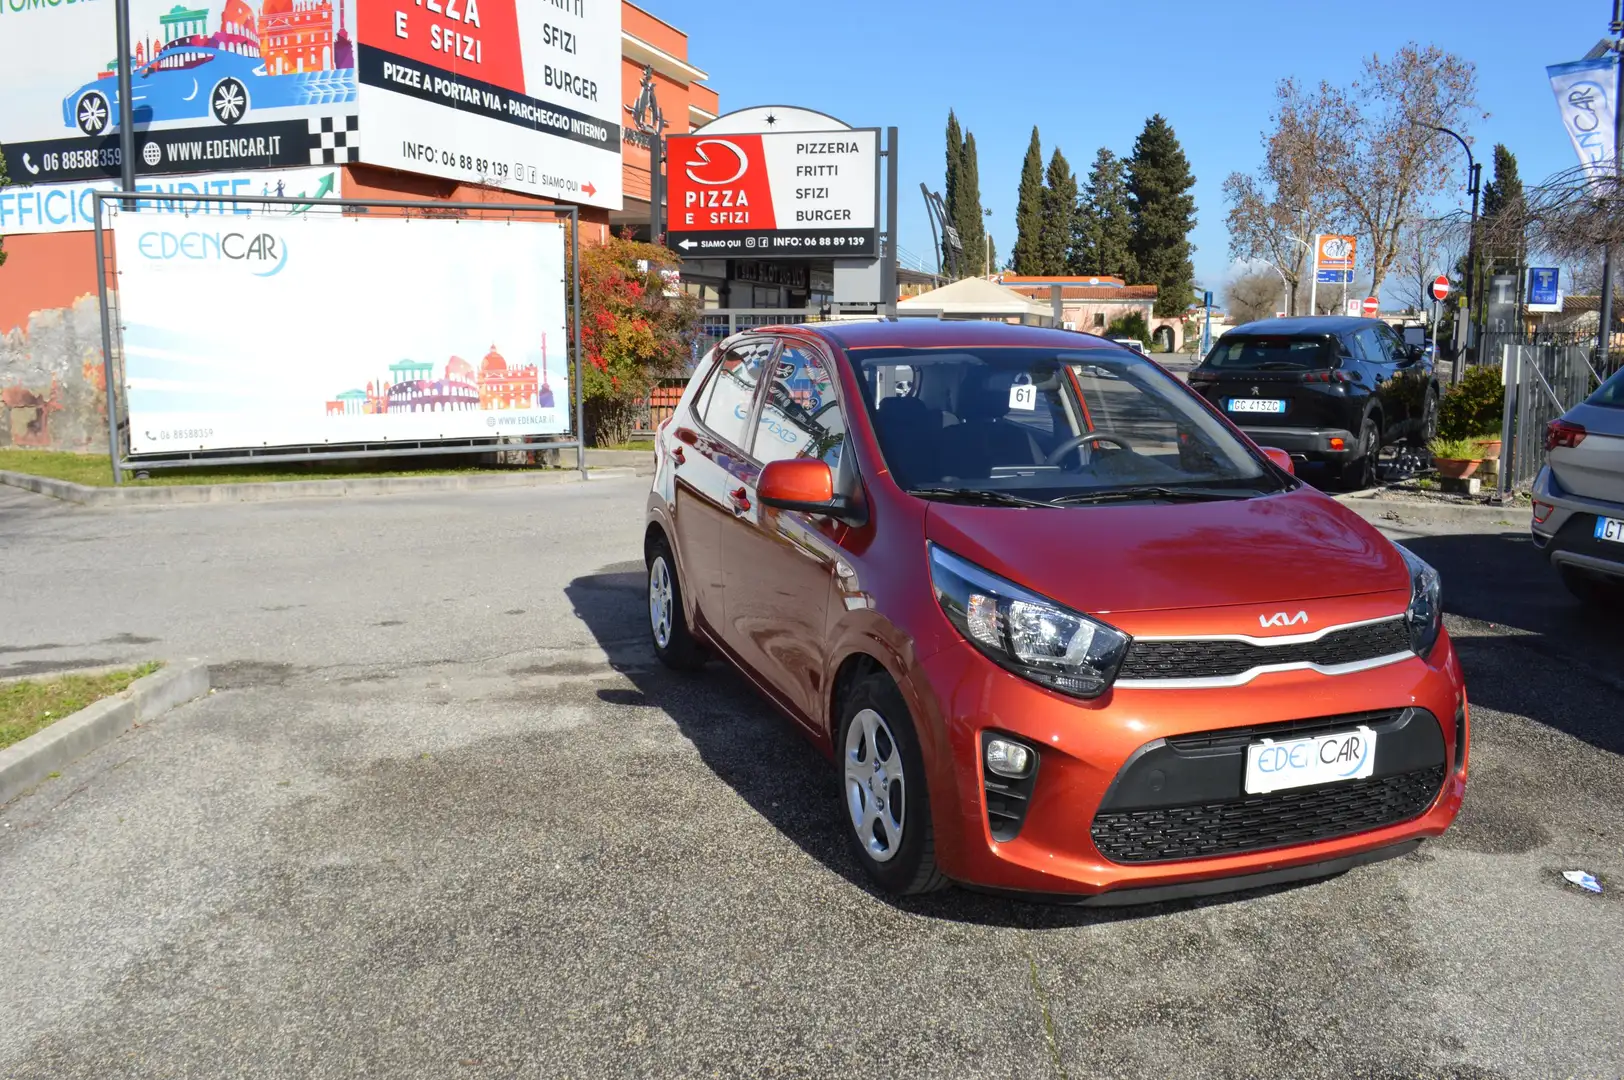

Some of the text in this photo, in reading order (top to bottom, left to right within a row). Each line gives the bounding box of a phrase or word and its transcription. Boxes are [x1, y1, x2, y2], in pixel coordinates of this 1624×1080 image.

[393, 10, 481, 64] E SFIZI
[543, 23, 577, 55] SFIZI
[544, 65, 598, 102] BURGER
[383, 61, 421, 89] PIZZE
[423, 74, 433, 92] A
[434, 77, 481, 106] PORTAR
[482, 91, 502, 111] VIA
[508, 99, 570, 130] PARCHEGGIO
[570, 118, 607, 142] INTERNO
[166, 135, 281, 162] WWW.EDENCAR.IT
[796, 142, 859, 154] PIZZERIA
[43, 147, 122, 171] 06 88588359
[403, 141, 508, 177] INFO: 06 88 89 139
[796, 165, 838, 177] FRITTI
[542, 174, 578, 192] SIAMO QUI
[685, 190, 749, 208] PIZZA
[796, 187, 829, 200] SFIZI
[685, 211, 749, 224] E SFIZI
[796, 209, 851, 222] BURGER
[138, 231, 278, 260] EDENCAR
[701, 236, 865, 249] SIAMO QUI INFO: 06 88 89 139
[1016, 388, 1031, 403] 61
[498, 415, 555, 425] WWW.EDENCAR.IT
[160, 428, 213, 440] 06 88588359
[1259, 611, 1309, 628] KIA
